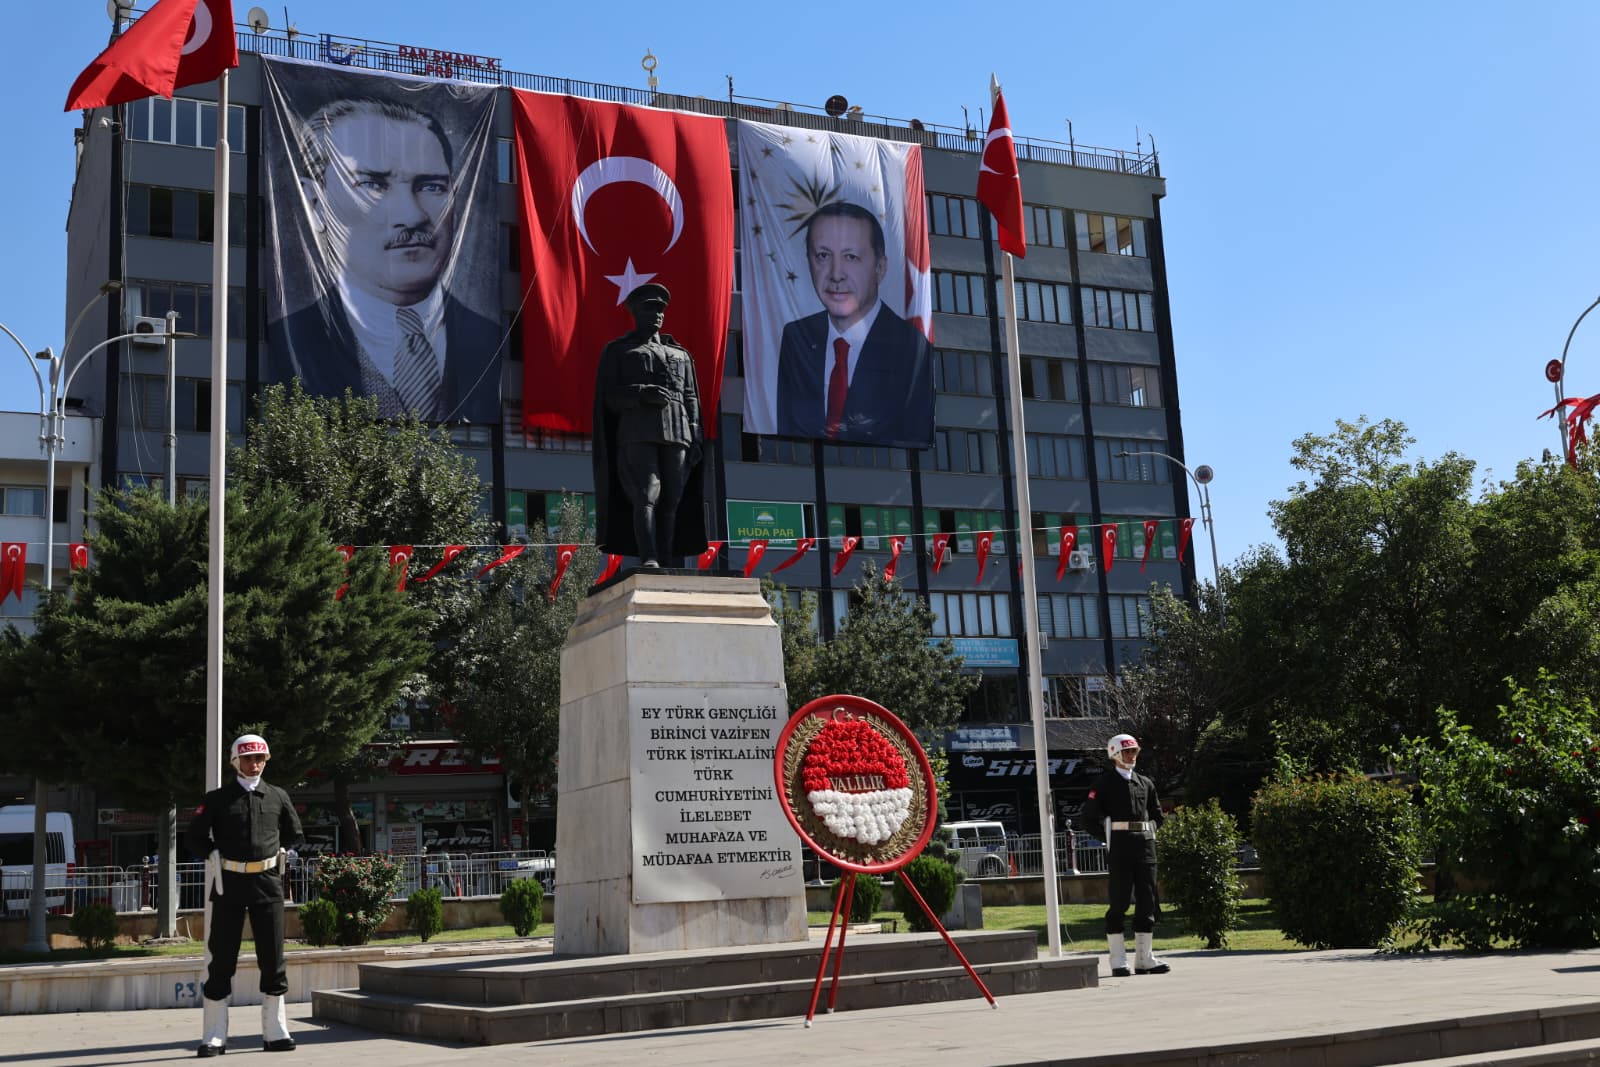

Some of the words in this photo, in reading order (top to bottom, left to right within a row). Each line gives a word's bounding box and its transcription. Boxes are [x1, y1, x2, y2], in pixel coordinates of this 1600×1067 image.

[772, 528, 795, 538] PAR
[641, 707, 661, 720] EY
[665, 705, 705, 720] TÜRK
[708, 705, 777, 723] GENÇLİĞİ
[650, 725, 707, 740] BİRİNCİ
[710, 725, 771, 740] VAZİFEN
[646, 746, 687, 761] TÜRK
[693, 766, 734, 780] TÜRK
[829, 774, 886, 792] VALİLİK
[655, 786, 773, 802] CUMHURİYETİNİ
[680, 808, 752, 823] İLELEBET
[666, 831, 745, 844] MUHAFAZA
[748, 830, 767, 841] VE
[642, 851, 713, 867] MÜDAFAA
[717, 847, 792, 864] ETMEKTİR
